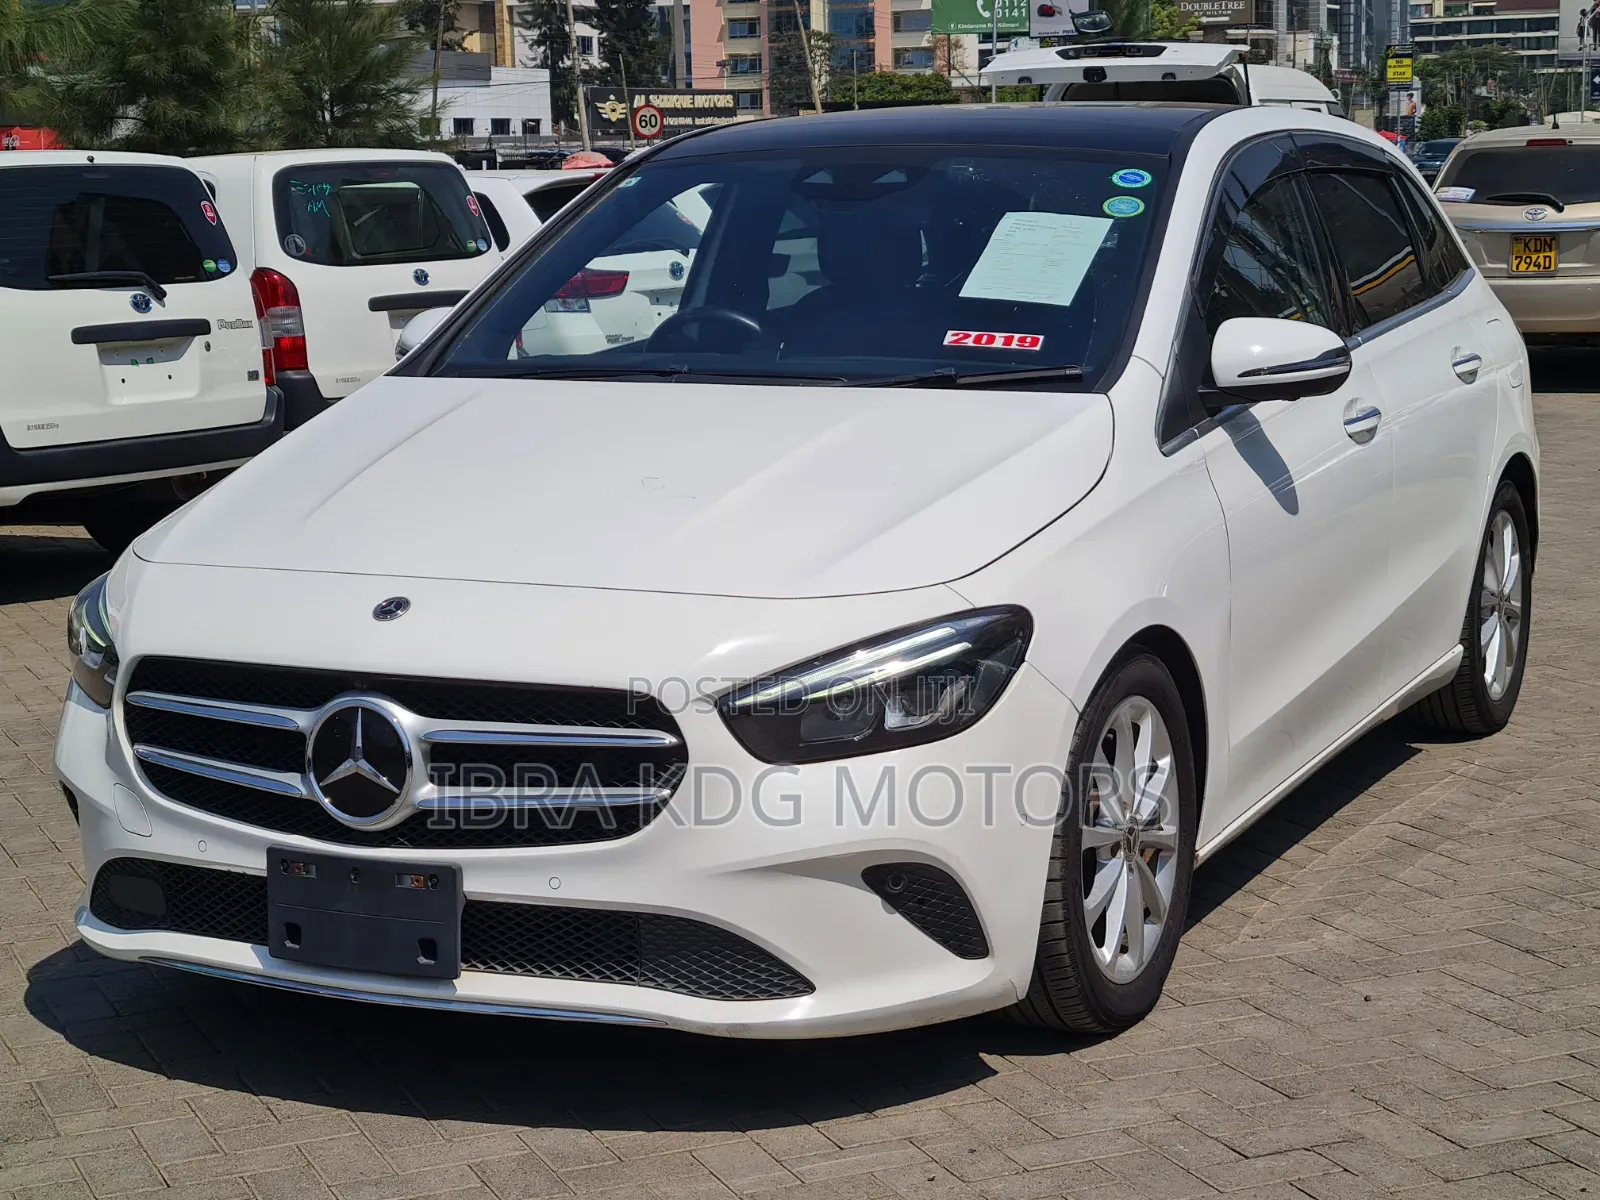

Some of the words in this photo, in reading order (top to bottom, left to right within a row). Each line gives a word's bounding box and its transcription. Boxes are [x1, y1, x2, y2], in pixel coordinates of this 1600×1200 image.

[996, 8, 1026, 18] 0141
[639, 114, 658, 129] 60
[1523, 237, 1553, 253] KDN
[1514, 255, 1552, 270] 794D
[947, 332, 1041, 348] 2019
